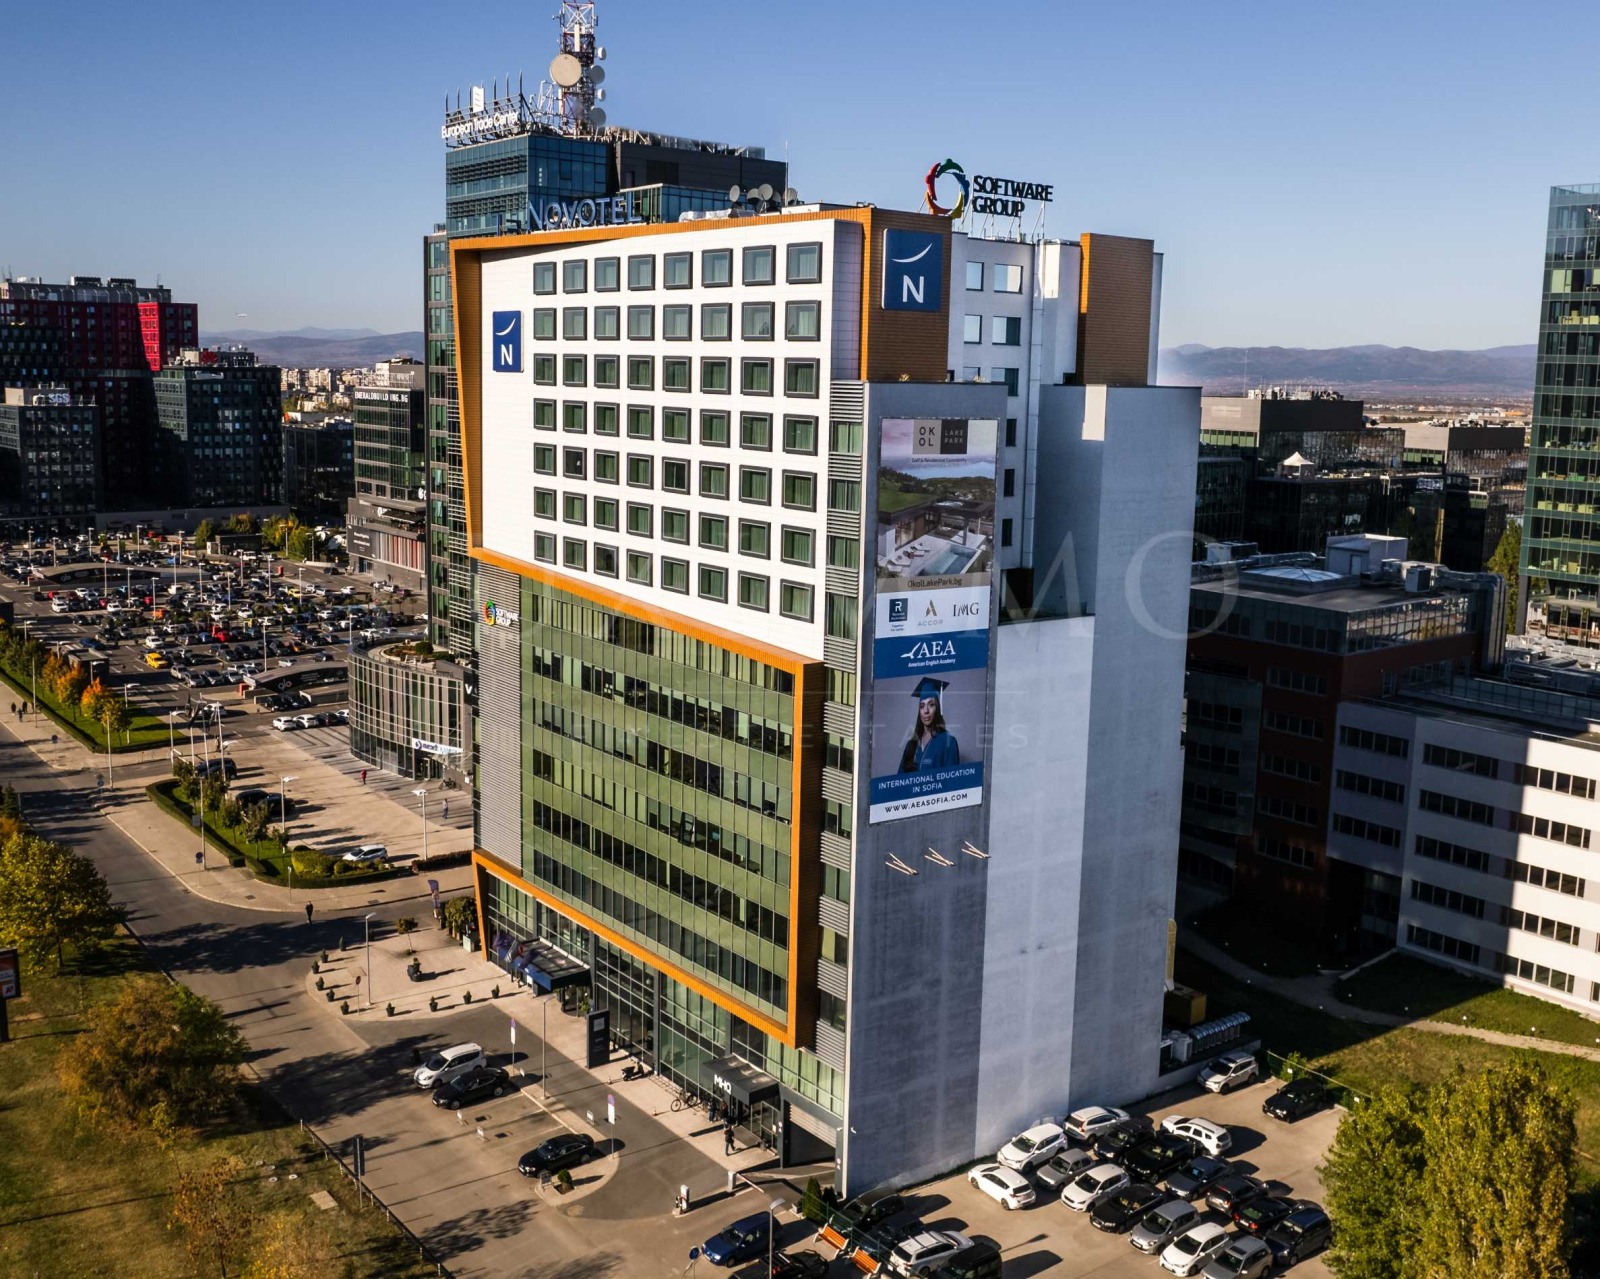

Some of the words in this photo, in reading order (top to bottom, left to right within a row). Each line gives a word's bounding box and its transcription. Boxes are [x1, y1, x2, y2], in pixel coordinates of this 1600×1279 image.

[441, 122, 473, 138] European
[473, 115, 493, 129] Trade
[493, 110, 519, 127] Center
[973, 175, 1054, 202] SOFTWARE
[526, 190, 642, 232] NOVOTEL
[972, 196, 1025, 217] GROUP
[902, 274, 925, 304] N
[501, 344, 513, 366] N
[48, 393, 70, 404] SGS
[953, 602, 980, 617] IMG
[917, 619, 944, 627] ACCOR
[917, 640, 957, 658] AEA
[878, 774, 934, 790] INTERNATIONAL
[936, 768, 976, 780] EDUCATION
[922, 782, 943, 791] SOFIA
[885, 793, 968, 812] WWW.AEASOFIA.COM
[714, 1074, 732, 1095] MHQ
